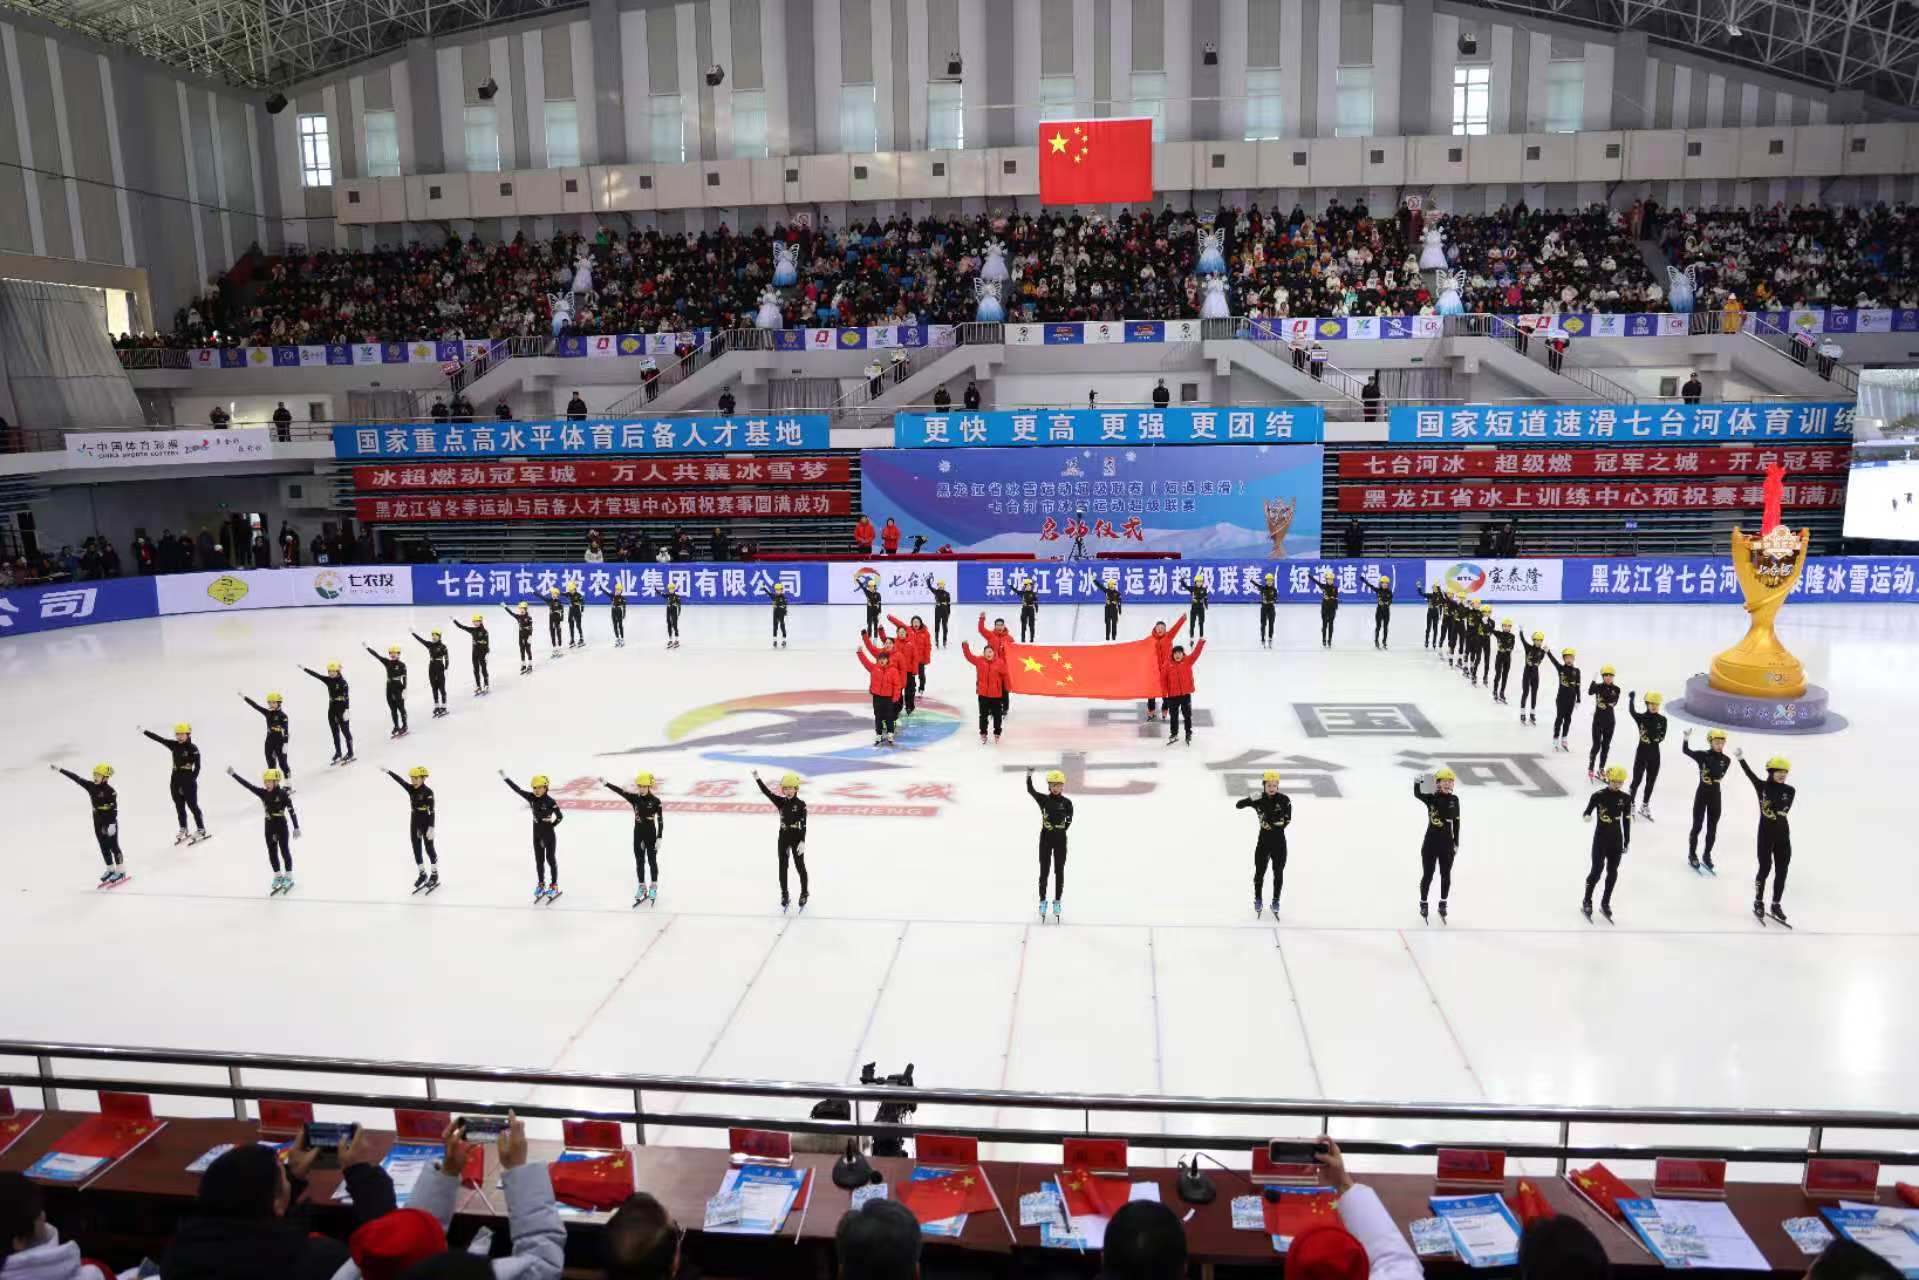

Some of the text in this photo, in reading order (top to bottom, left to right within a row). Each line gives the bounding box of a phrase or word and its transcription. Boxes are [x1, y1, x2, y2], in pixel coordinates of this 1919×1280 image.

[356, 419, 804, 454] 国家重点高水平体育后备人才基地
[923, 411, 1295, 443] 更快 更高 更强 更团结
[1040, 516, 1144, 543] 启动仪式
[1489, 566, 1542, 584] 宝泰隆
[1002, 748, 1571, 799] 七台河
